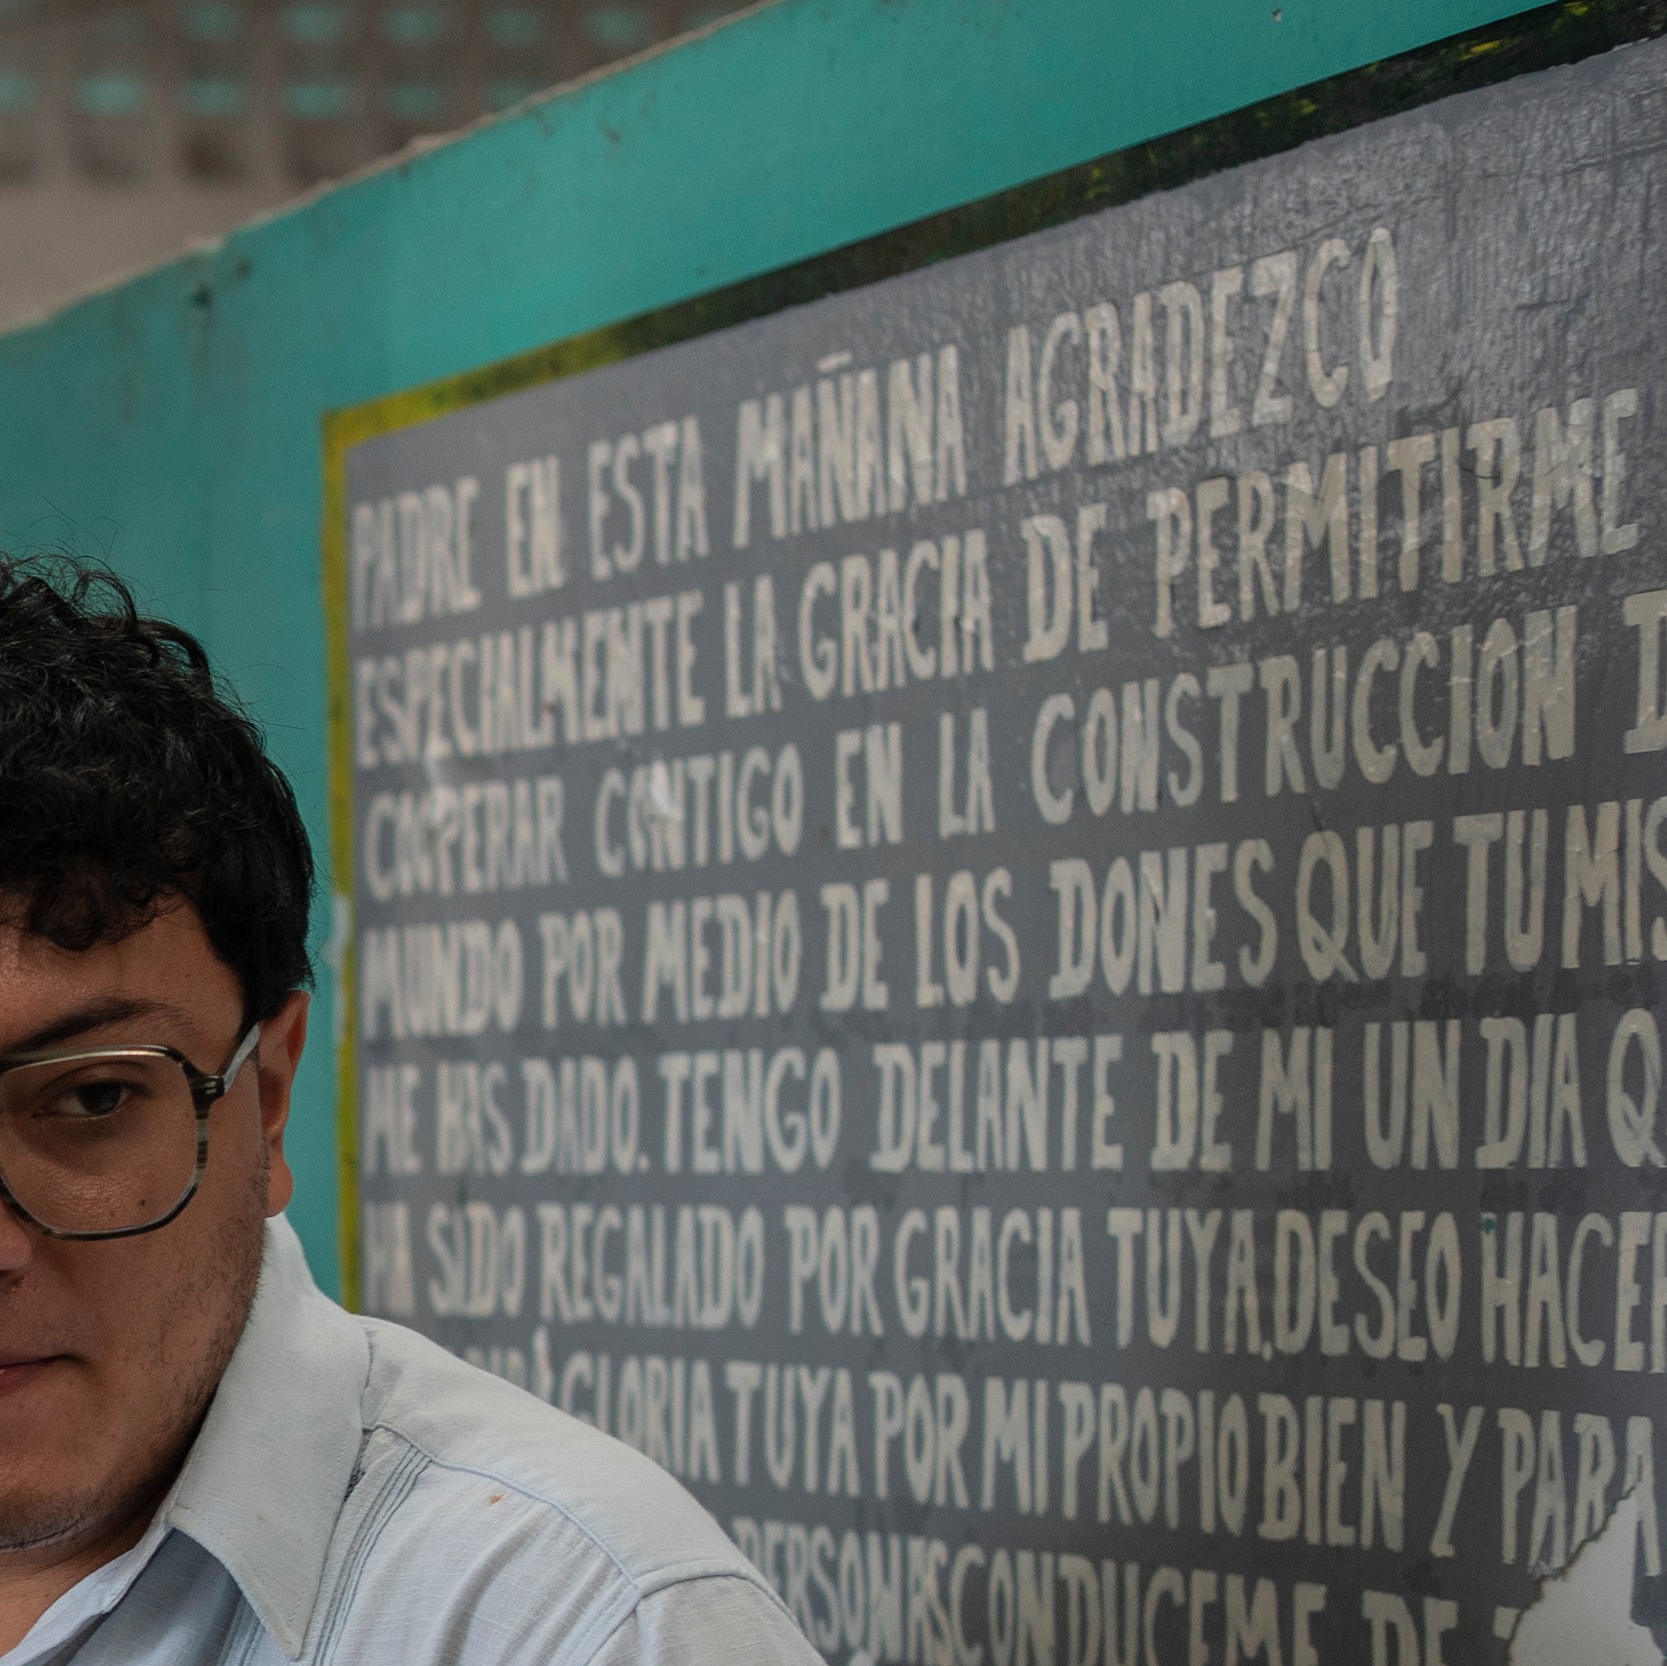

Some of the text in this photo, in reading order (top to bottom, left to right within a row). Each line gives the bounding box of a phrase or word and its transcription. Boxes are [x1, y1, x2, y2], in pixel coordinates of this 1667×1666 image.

[353, 226, 1399, 632] PADRE EN ESTA MAÑANA AGRADEZCO
[357, 387, 1639, 768] ESPECIALMENTE LA GRACIA DE PERMITIRME
[595, 743, 804, 878] CONTIGO
[835, 722, 904, 850] EN
[939, 710, 998, 838] LA
[1032, 604, 1577, 828] CONSTRUCCION
[364, 918, 524, 1039] MUNDO
[538, 907, 627, 1031] POR
[643, 890, 801, 1023] MEDIO
[821, 882, 889, 1012] DE
[917, 868, 1019, 1003] LOS
[1050, 837, 1279, 995] DONES
[1295, 819, 1435, 984] QUE
[1453, 809, 1548, 976] TU
[365, 1064, 422, 1176] ME
[437, 1060, 513, 1176] HAS
[520, 1056, 651, 1176] DADO.
[659, 1046, 841, 1175] TENGO
[870, 1034, 1124, 1174] DELANTE
[1152, 1030, 1234, 1173] DE
[1255, 1026, 1333, 1172] MI
[1363, 1018, 1462, 1171] UN
[1475, 1012, 1588, 1170] DIA
[425, 1201, 527, 1318] SIDO
[535, 1203, 766, 1329] REGALADO
[785, 1206, 882, 1338] POR
[896, 1207, 1093, 1347] GRACIA
[1274, 1209, 1462, 1361] DESEO
[725, 1359, 860, 1499] TUYA
[870, 1371, 970, 1511] POR
[984, 1378, 1050, 1518] MI
[1060, 1383, 1249, 1539] PROPIO
[1257, 1393, 1406, 1552] BIEN
[1430, 1402, 1485, 1558] Y
[1497, 1407, 1662, 1577] PARA
